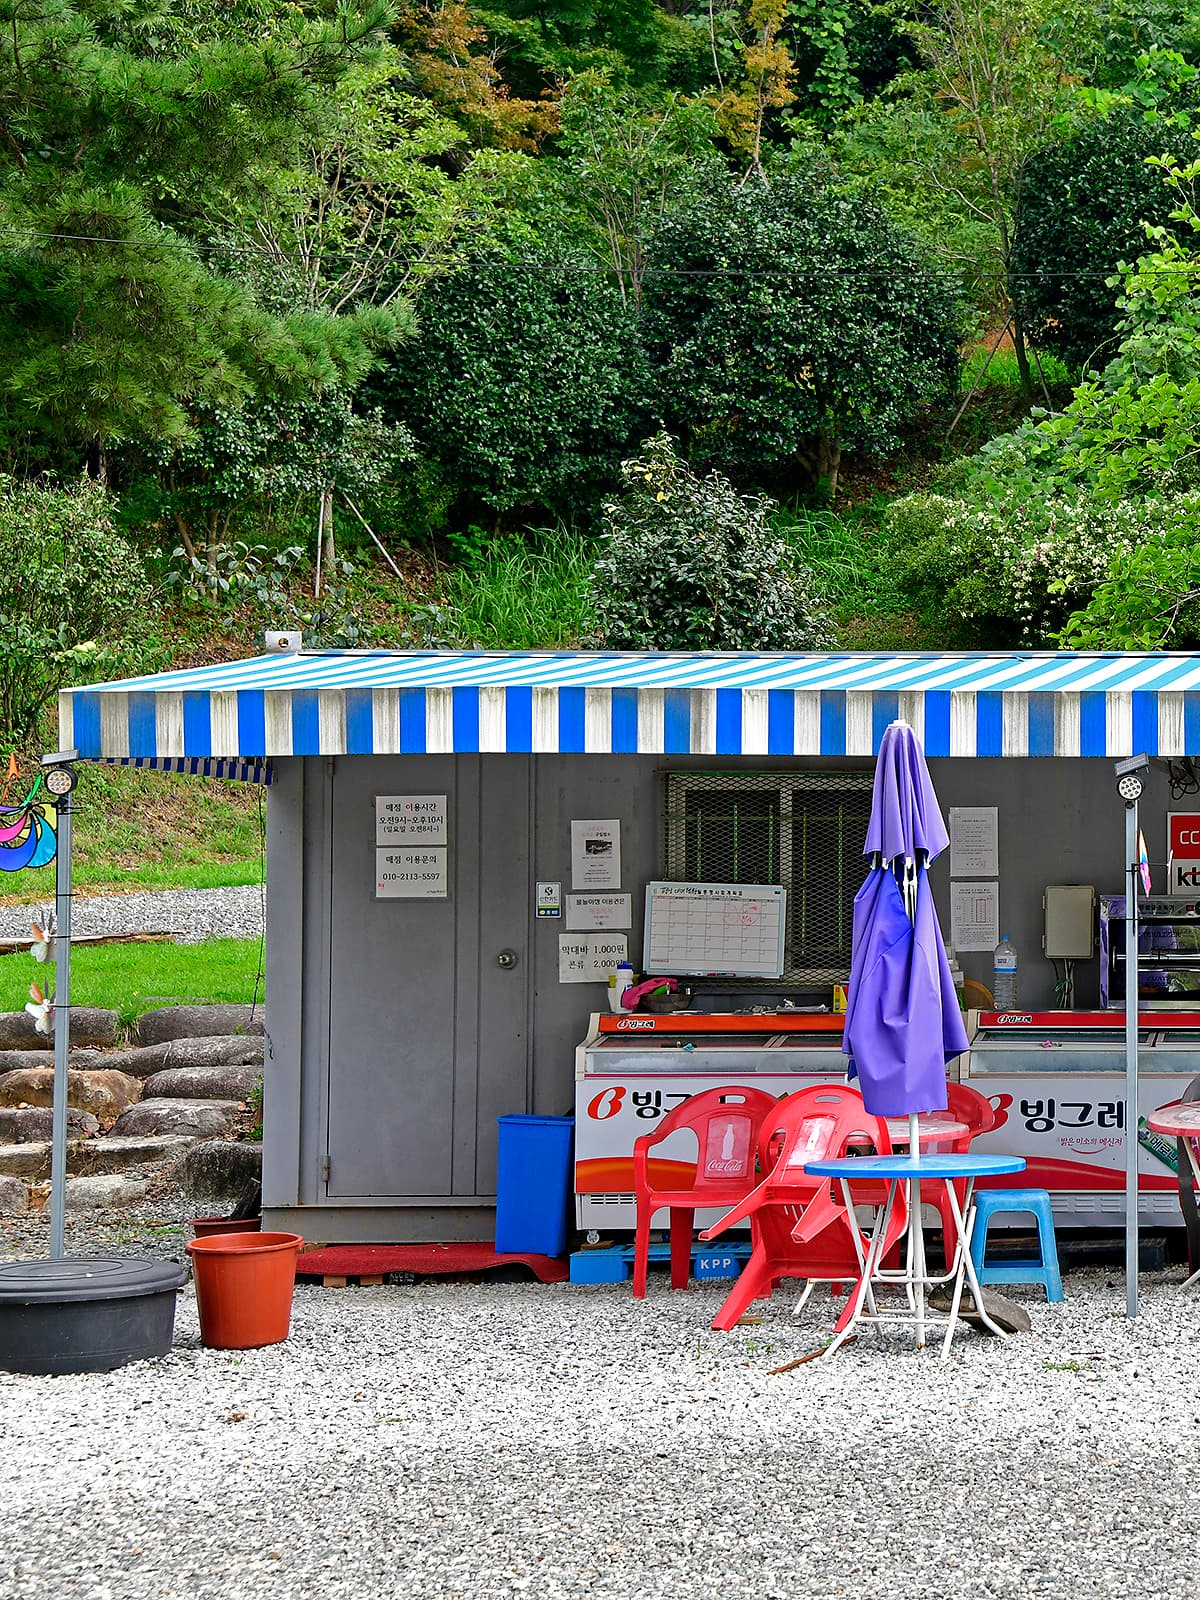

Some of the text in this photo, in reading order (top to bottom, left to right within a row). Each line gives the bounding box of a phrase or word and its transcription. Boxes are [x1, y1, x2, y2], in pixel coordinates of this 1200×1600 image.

[405, 803, 437, 812] 이용시간
[405, 855, 437, 864] 이용문의
[382, 872, 440, 881] 010-2113-5597
[1177, 866, 1200, 887] kt
[562, 945, 588, 955] 막대바
[1020, 1098, 1127, 1132] 빙그레
[1060, 1137, 1123, 1147] 밝은 미소의 메신저
[700, 1258, 731, 1270] KPP
